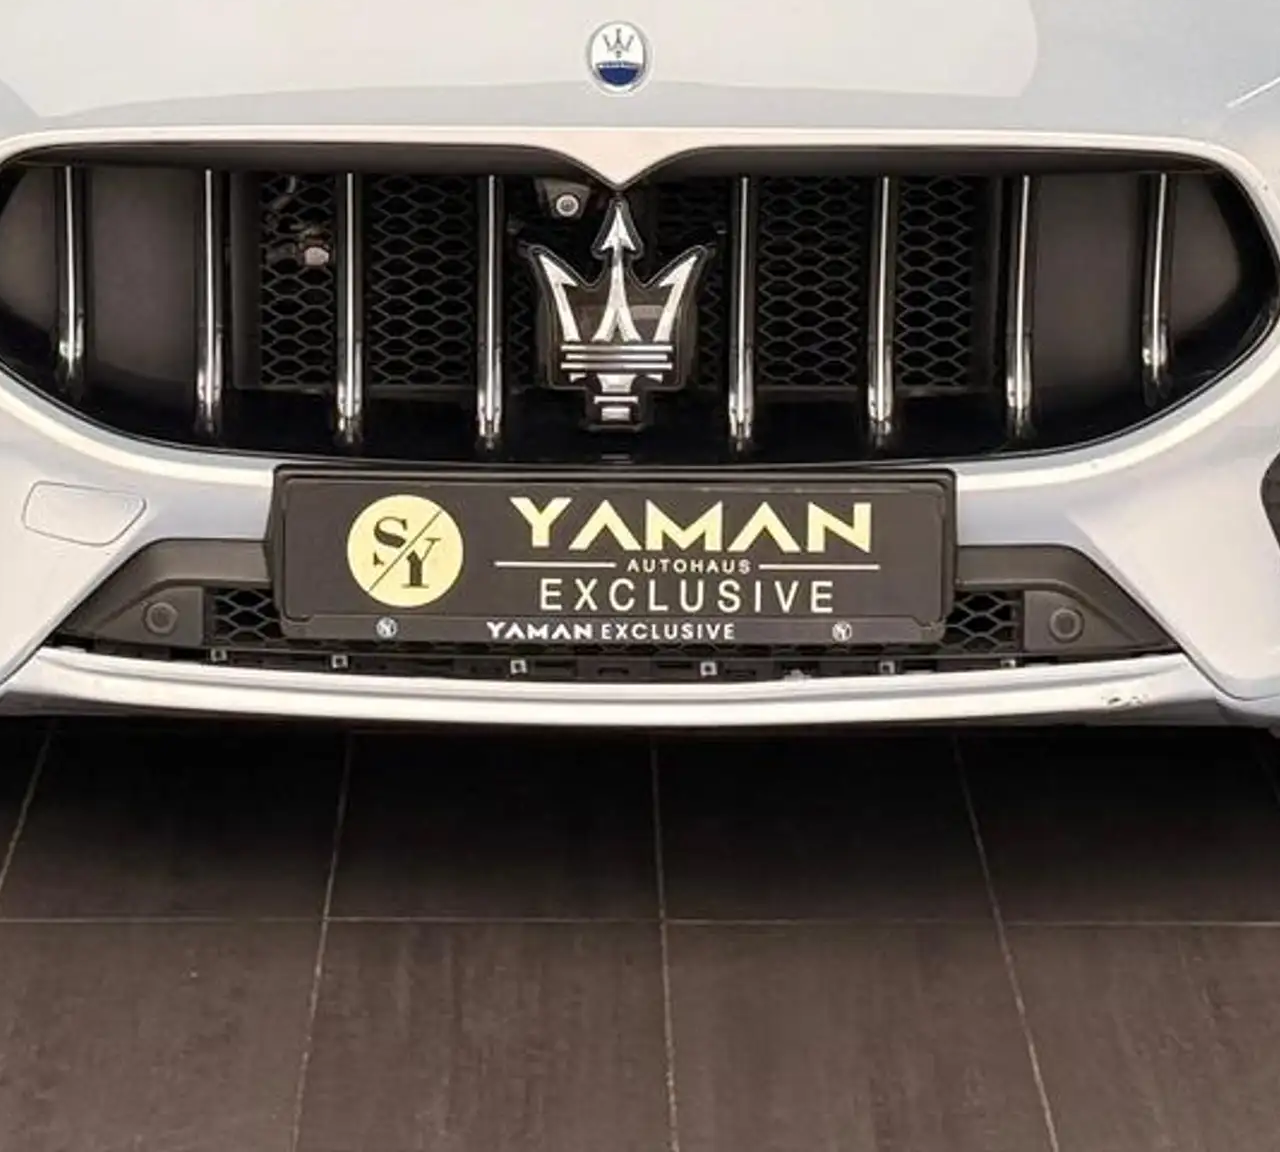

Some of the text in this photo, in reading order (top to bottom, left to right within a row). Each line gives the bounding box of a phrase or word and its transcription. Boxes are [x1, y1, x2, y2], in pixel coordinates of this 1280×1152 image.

[509, 496, 872, 553] YAMAN
[627, 558, 751, 574] AUTOHAUS
[540, 578, 834, 614] EXCLUSIVE
[486, 621, 736, 640] YAMAN EXCLUSIVE
